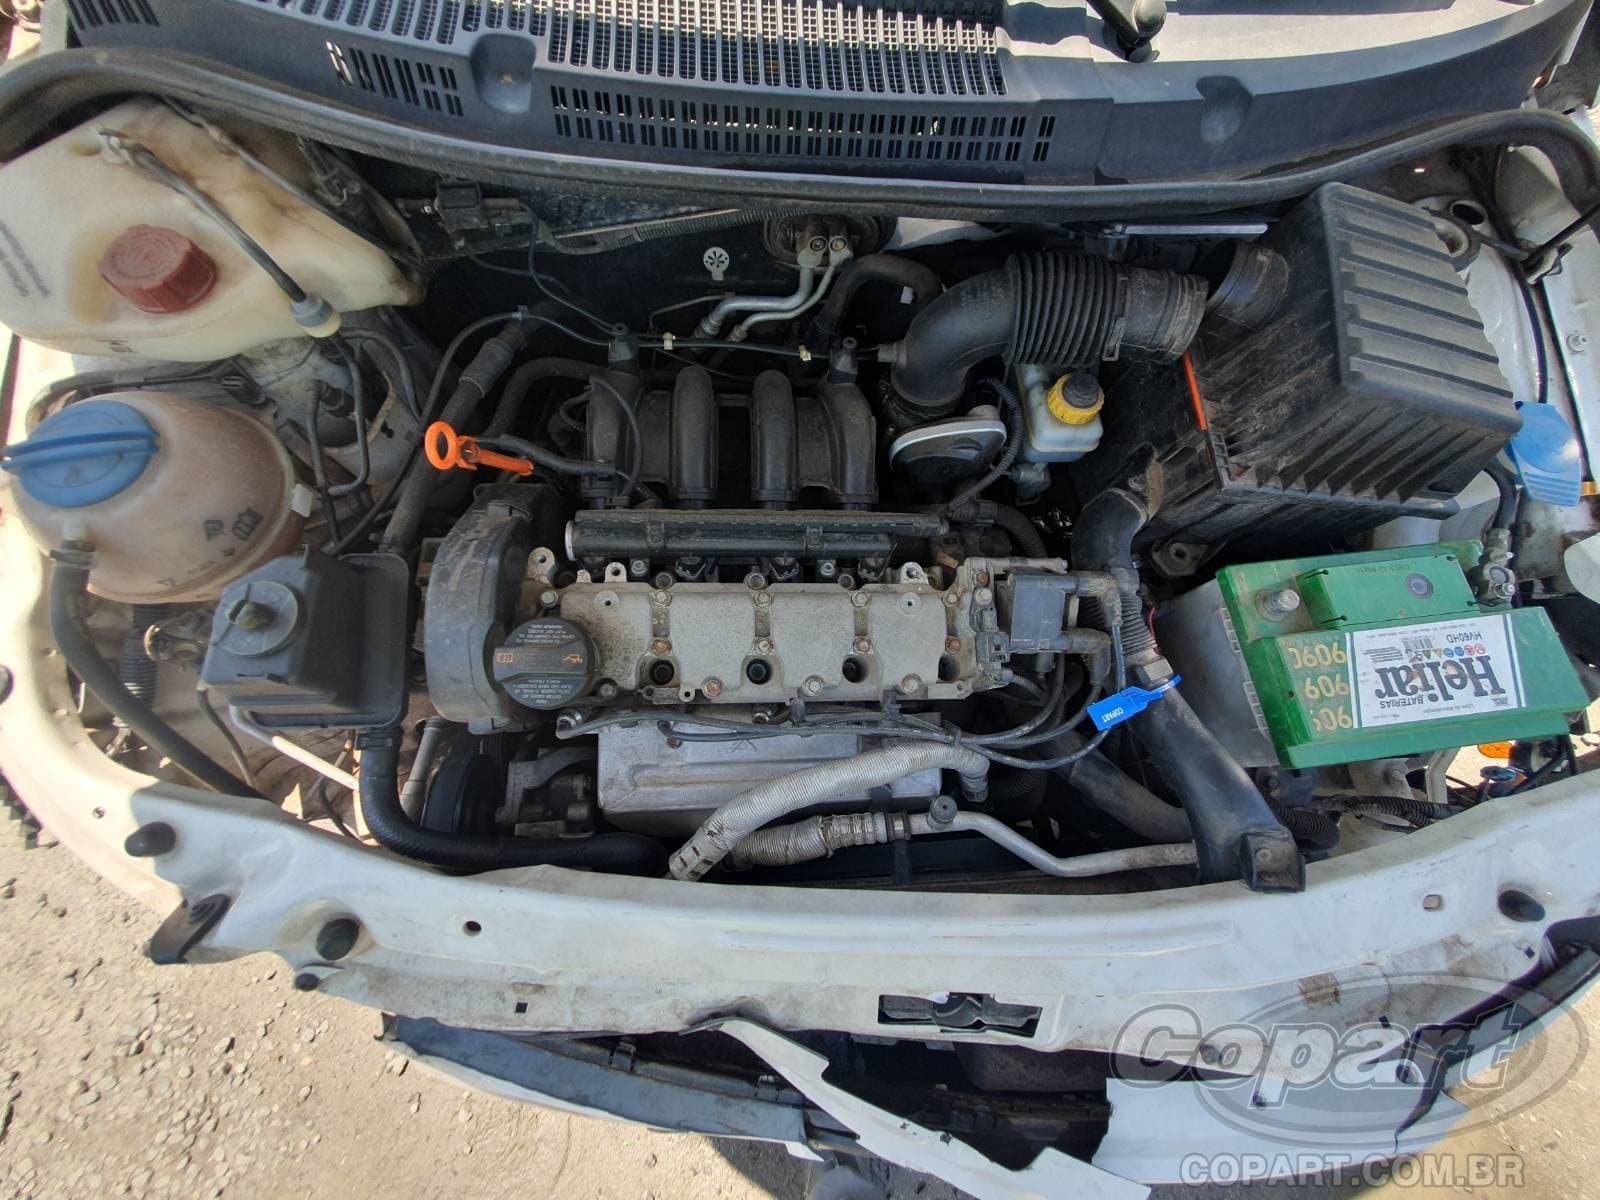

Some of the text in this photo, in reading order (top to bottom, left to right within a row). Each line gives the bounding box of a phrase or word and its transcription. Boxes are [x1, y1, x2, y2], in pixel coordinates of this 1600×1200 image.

[1305, 674, 1349, 700] 909
[1374, 655, 1506, 703] Heliar
[1378, 696, 1424, 710] BATERIAS
[1101, 707, 1124, 722] COPART
